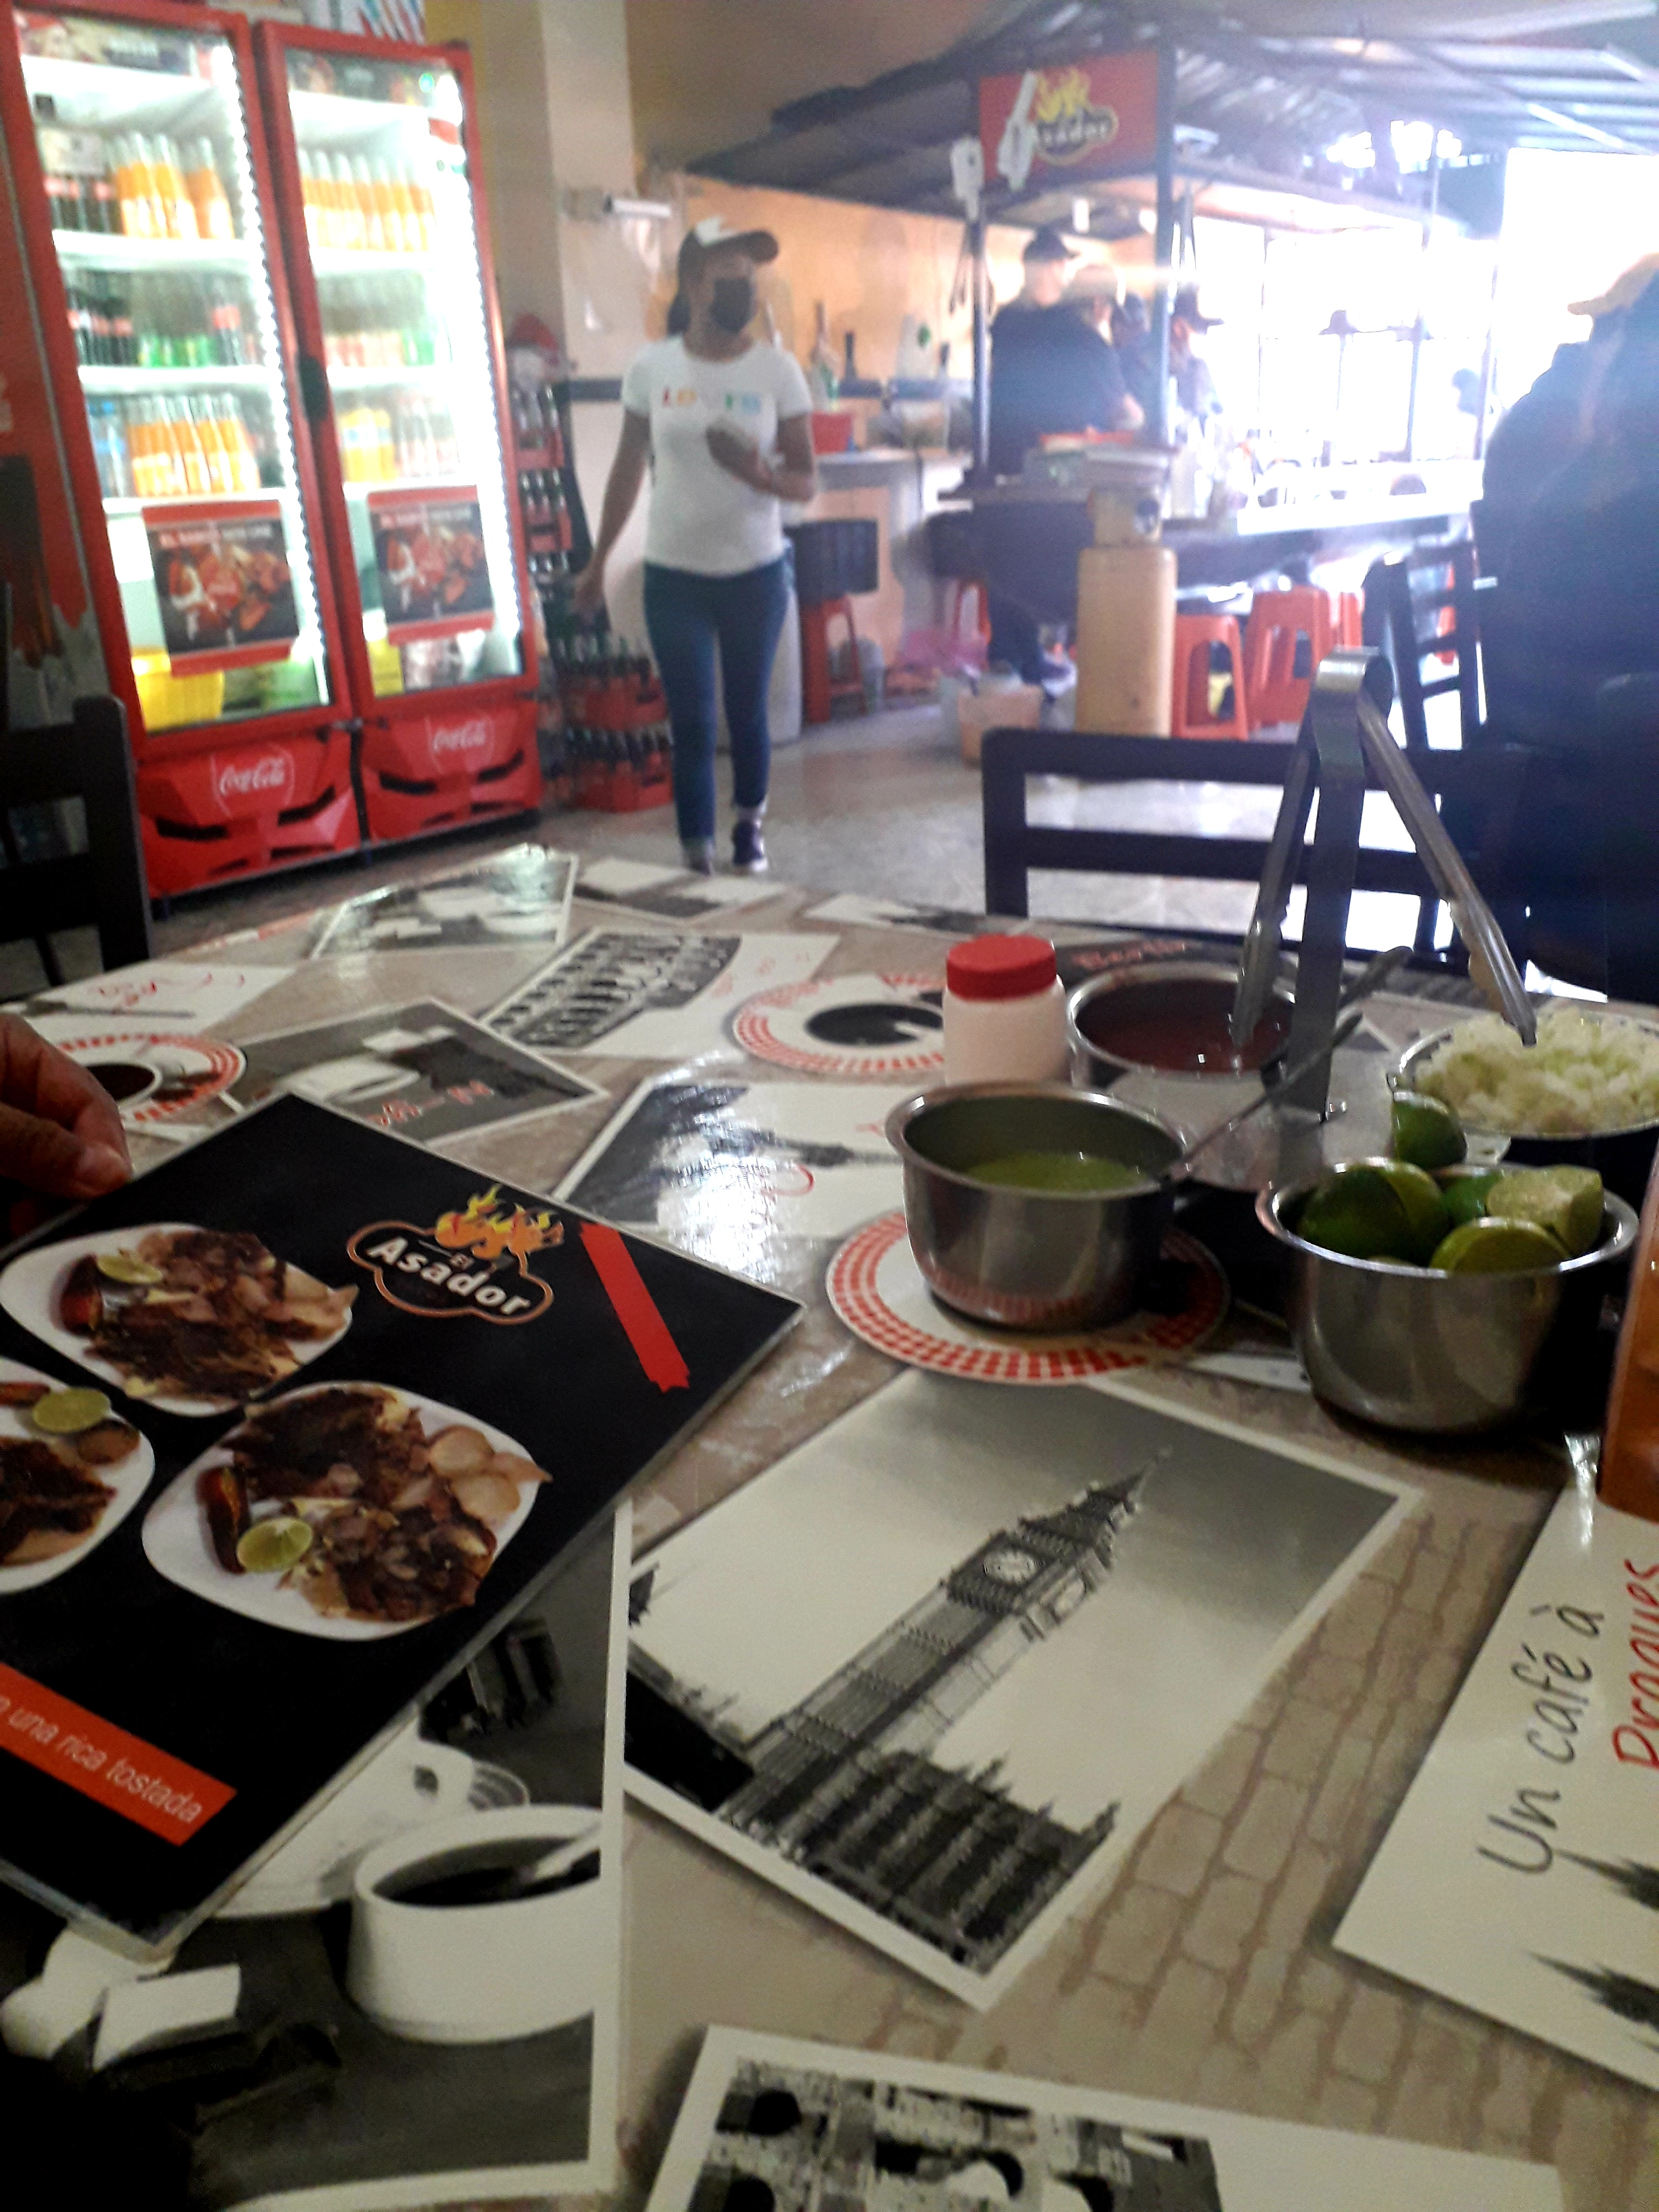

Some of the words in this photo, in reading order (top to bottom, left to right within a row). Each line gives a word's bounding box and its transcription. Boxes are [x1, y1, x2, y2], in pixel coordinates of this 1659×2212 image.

[218, 757, 286, 797] Coca-Cola
[366, 1237, 531, 1316] Asador
[1529, 1604, 1605, 1638] à
[1511, 1642, 1593, 1764] café
[8, 1708, 59, 1745] una
[56, 1734, 108, 1772] rica
[105, 1757, 203, 1823] tostada
[1476, 1788, 1561, 1875] Un
